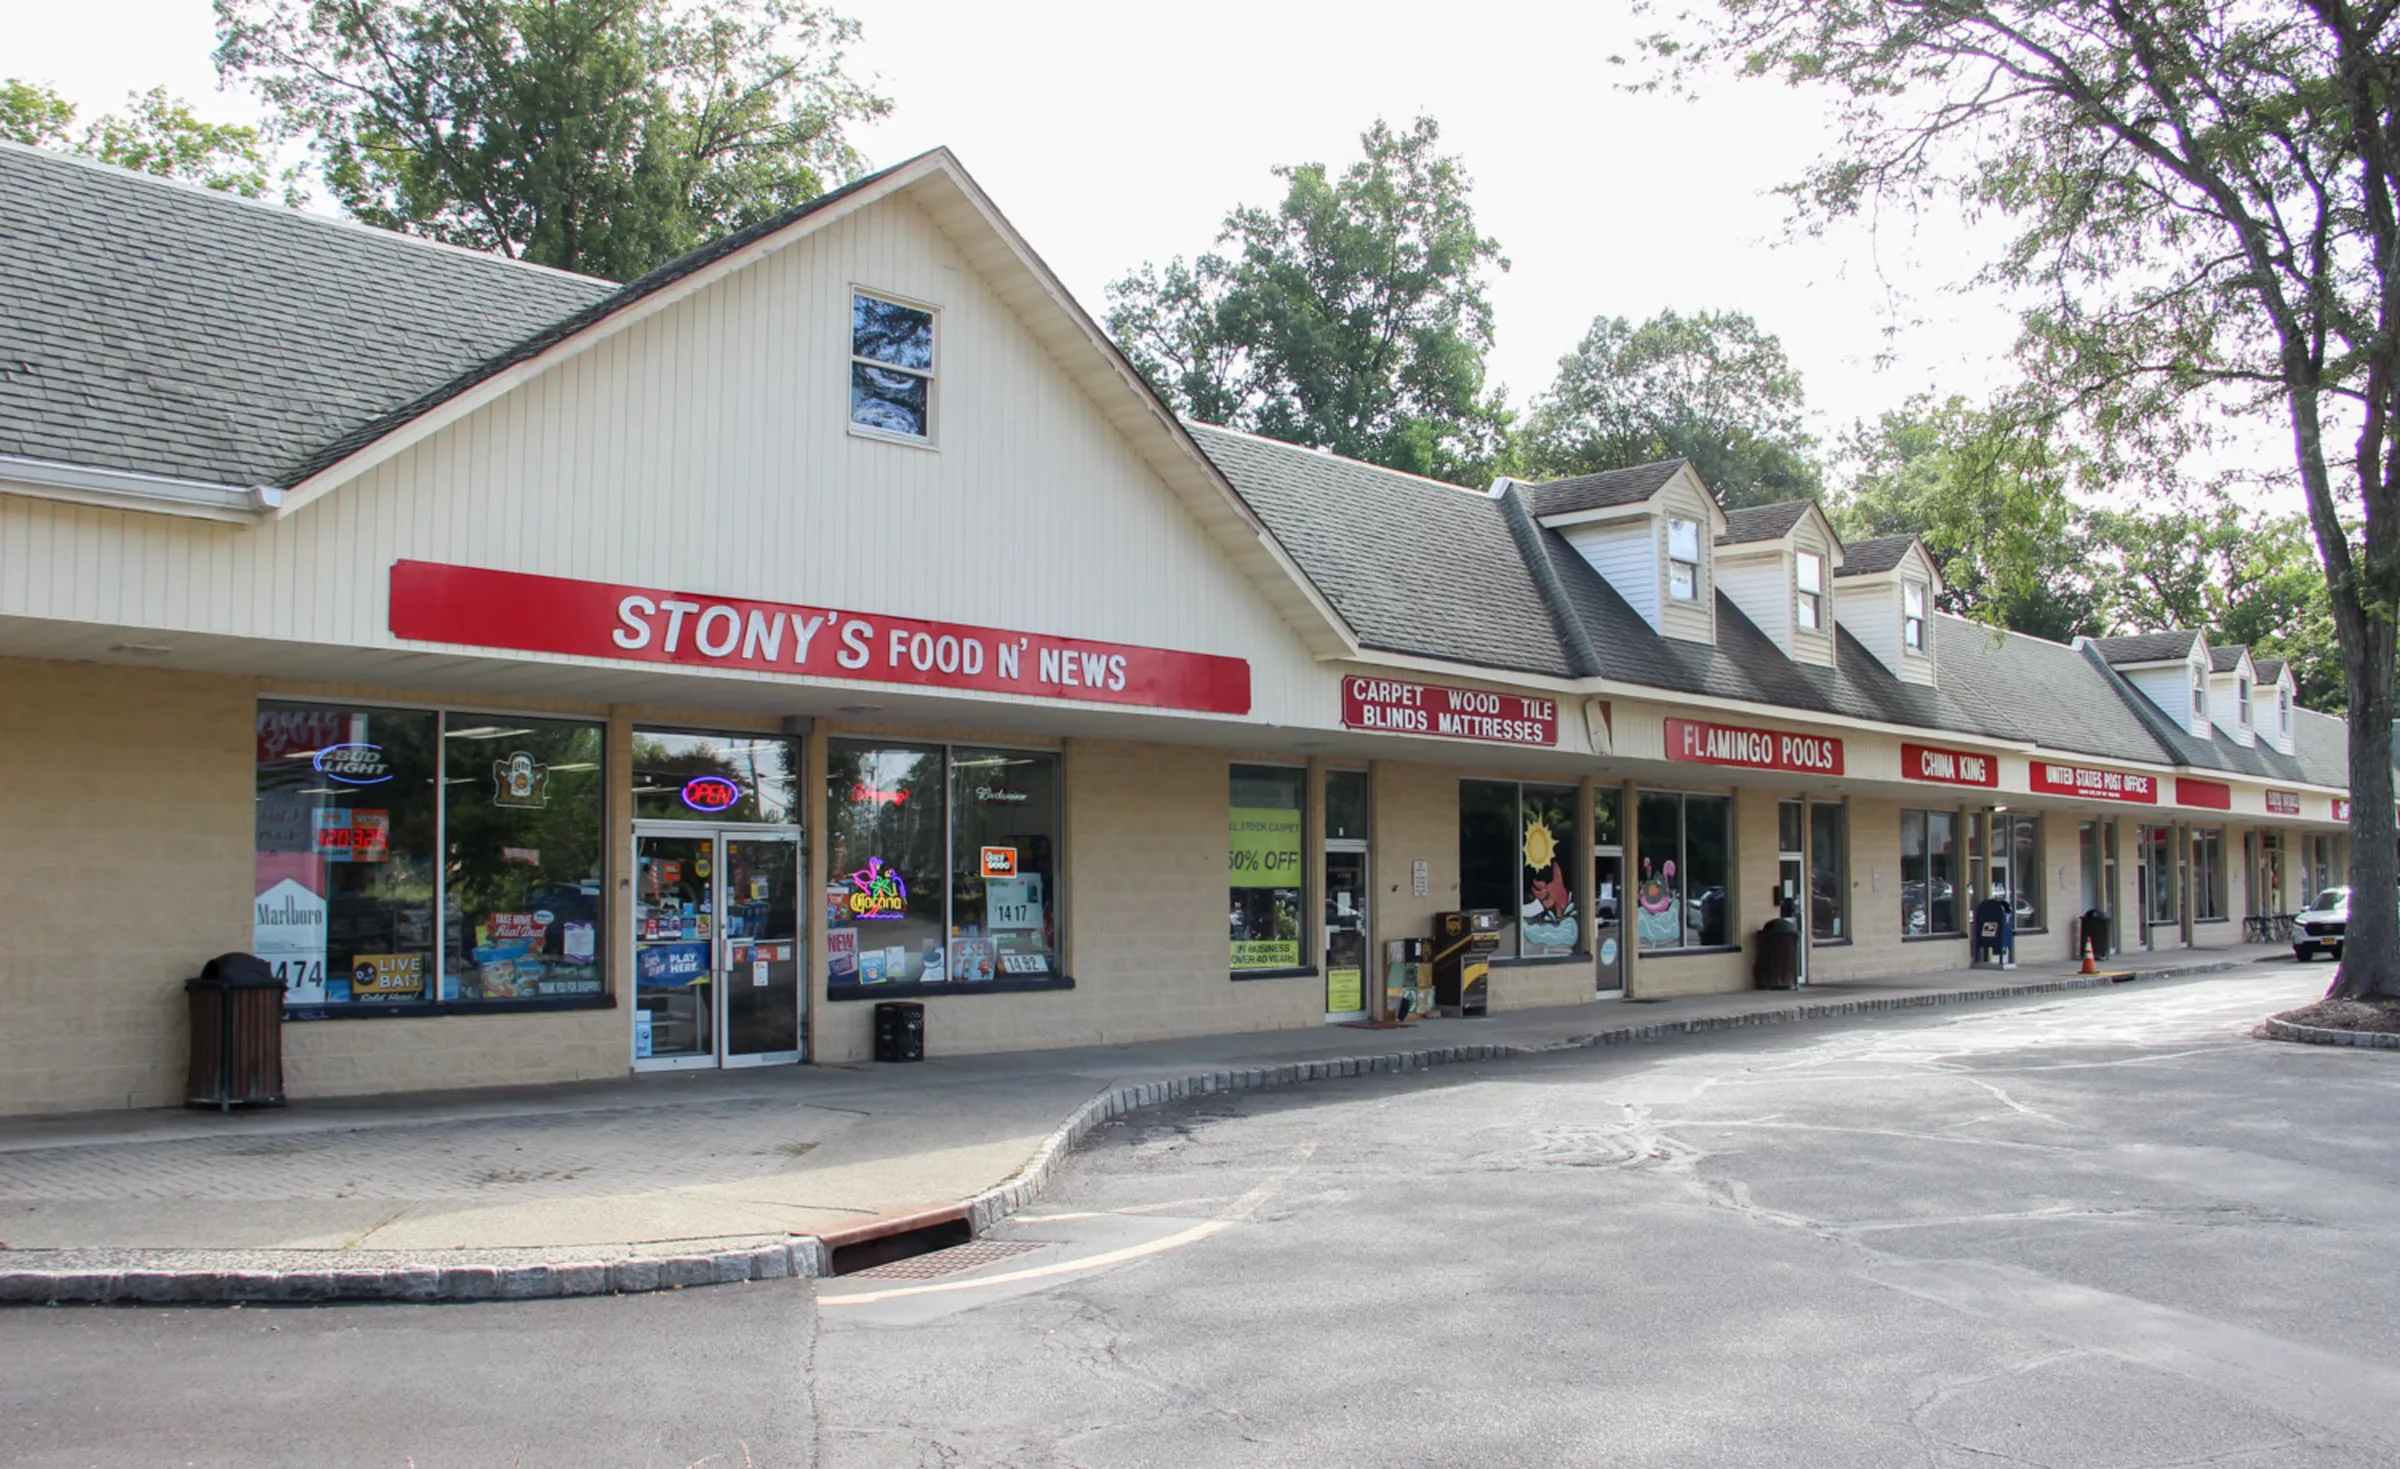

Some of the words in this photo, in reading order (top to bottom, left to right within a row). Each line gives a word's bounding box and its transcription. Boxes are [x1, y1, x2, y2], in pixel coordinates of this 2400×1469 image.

[612, 595, 873, 670] STONY'S
[889, 629, 984, 675] FOOD
[997, 637, 1028, 680] N'
[1039, 648, 1127, 691] NEWS
[1353, 679, 1424, 706] CARPET
[1448, 690, 1500, 714] WOOD
[1521, 699, 1553, 720] TILE
[1363, 705, 1428, 730] BLINDS
[1438, 713, 1543, 742] MATTRESSES
[335, 751, 380, 763] BUD
[1684, 725, 1773, 764] FLAMINGO
[1782, 735, 1833, 769] POOLS
[323, 763, 388, 774] LIGHT
[1921, 751, 1954, 779] CHINA
[1959, 755, 1986, 782] KING
[2046, 765, 2074, 785] UNITED
[2076, 768, 2102, 789] STATES
[2104, 772, 2121, 791] POST
[2123, 774, 2148, 794] OFFICE
[687, 783, 733, 805] OPEN
[1228, 822, 1238, 831] LL
[1241, 822, 1267, 831] STOCK
[1269, 823, 1300, 833] CARPET
[352, 829, 388, 848] 325
[1265, 850, 1299, 871] OFF
[257, 895, 323, 926] Marlboro
[850, 893, 902, 913] Corona
[828, 933, 854, 954] NEW
[1248, 943, 1290, 953] BUSINESS
[379, 958, 422, 972] LIVE
[670, 953, 696, 963] PLAY
[670, 963, 697, 973] HERE
[1231, 955, 1253, 964] OVER
[1256, 955, 1268, 964] 40
[1269, 955, 1297, 964] YEARS
[379, 974, 421, 988] BAIT
